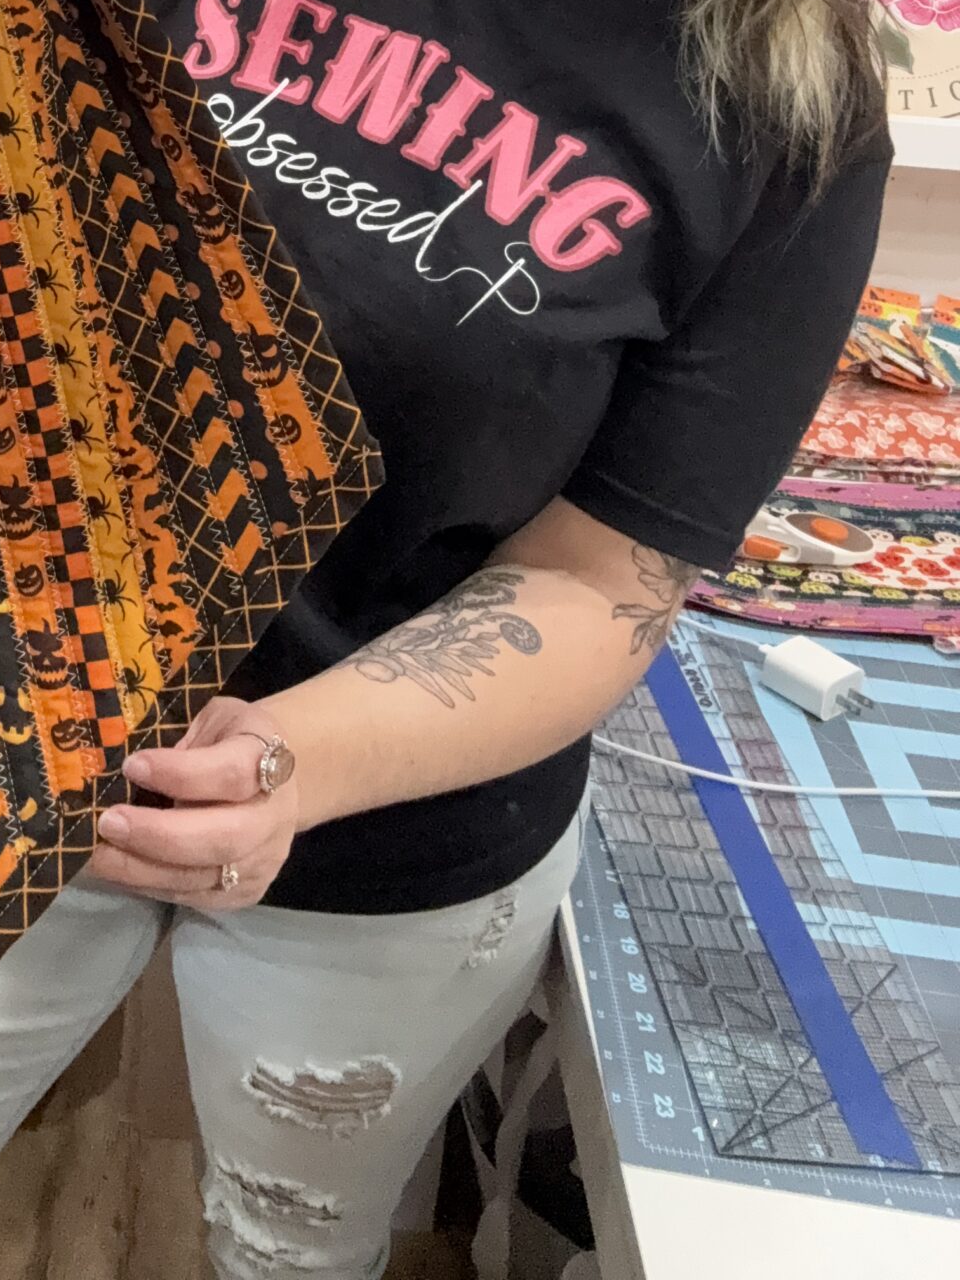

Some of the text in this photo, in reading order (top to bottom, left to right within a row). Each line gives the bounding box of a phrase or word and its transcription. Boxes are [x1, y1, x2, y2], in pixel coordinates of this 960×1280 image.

[207, 78, 483, 273] obsessed
[613, 902, 631, 920] 18
[620, 936, 639, 955] 19
[627, 972, 647, 994] 20
[635, 1011, 656, 1033] 21
[644, 1050, 665, 1075] 22
[653, 1093, 675, 1119] 23
